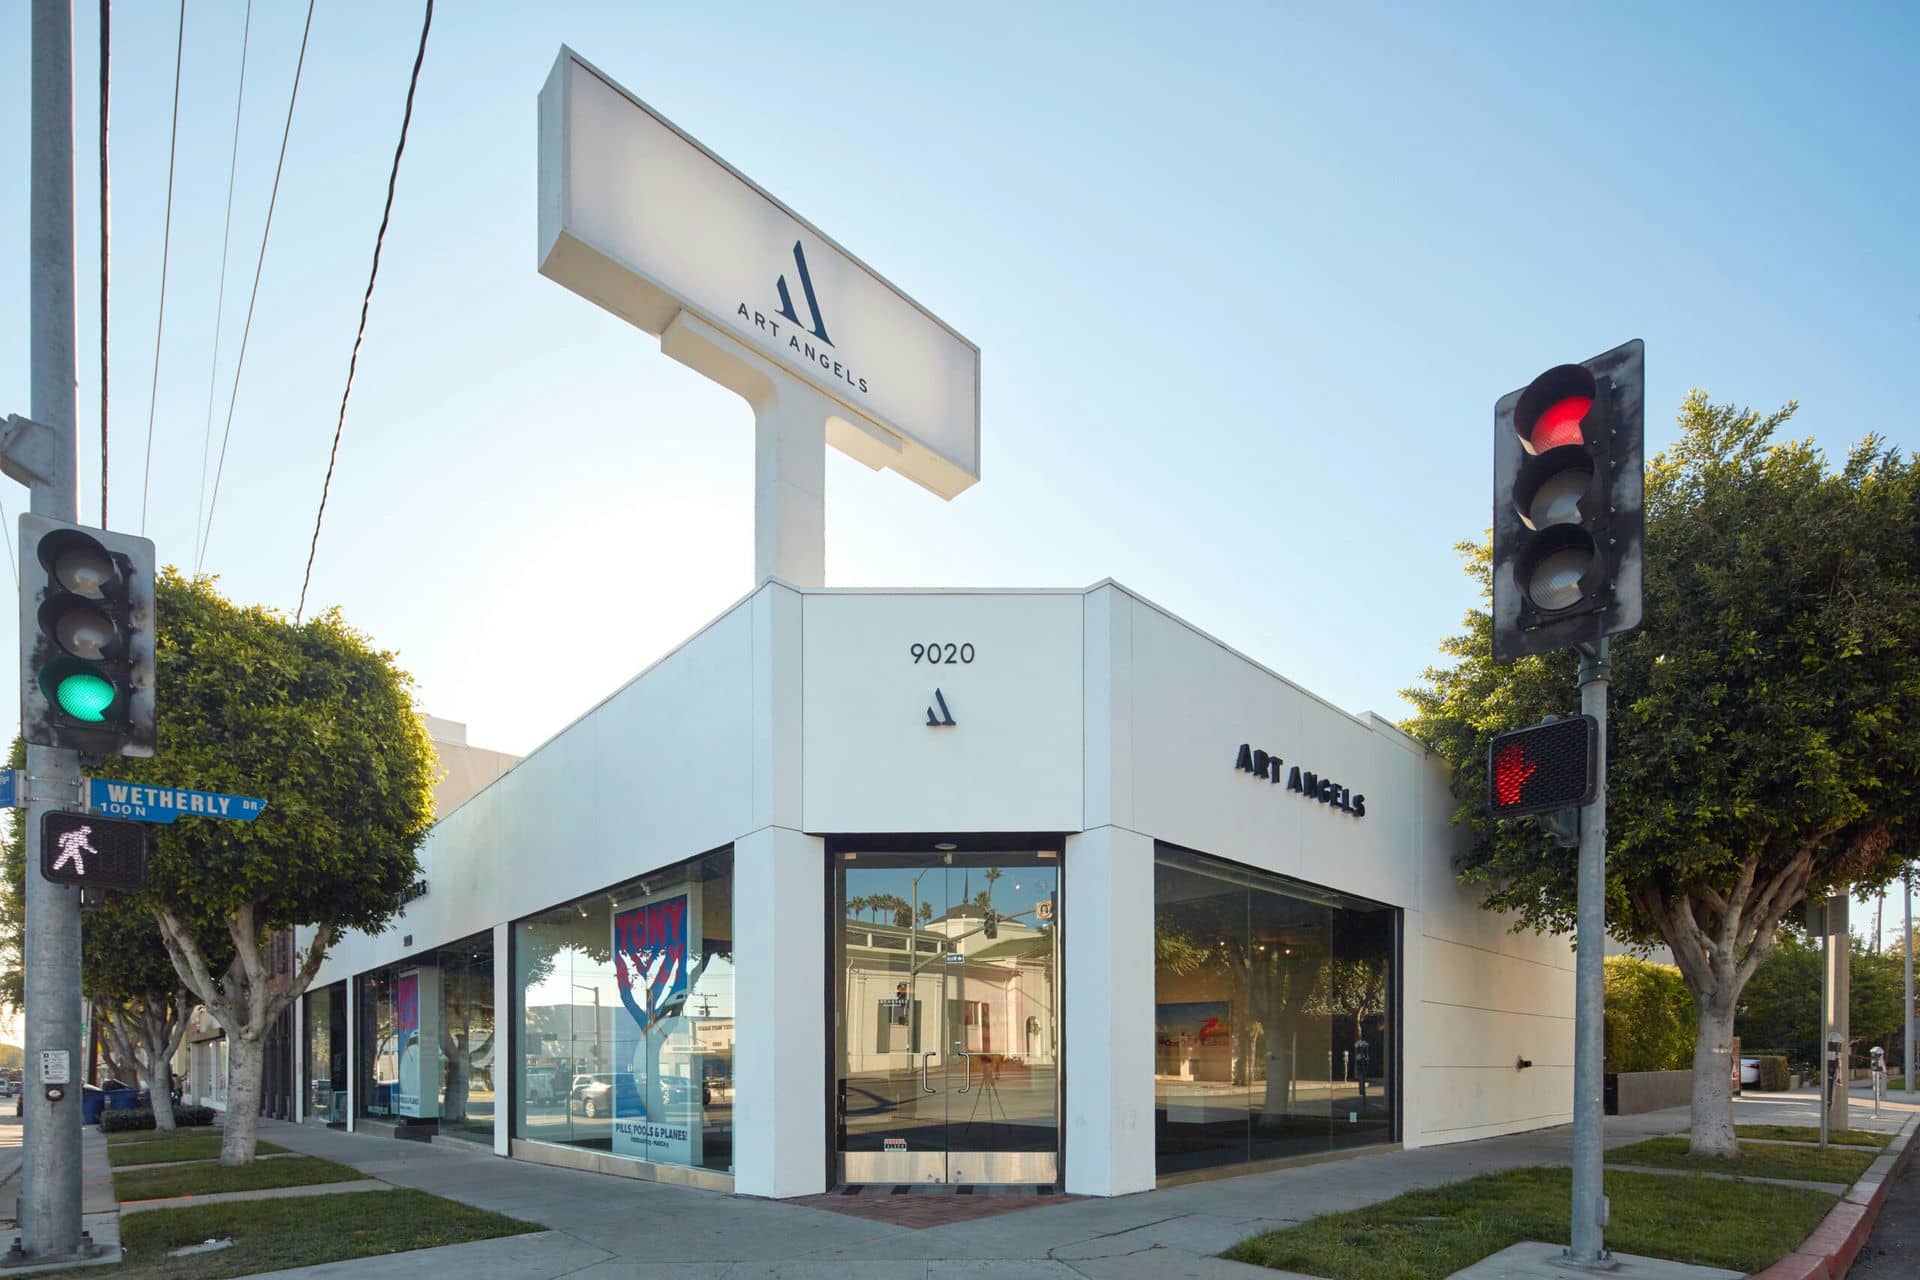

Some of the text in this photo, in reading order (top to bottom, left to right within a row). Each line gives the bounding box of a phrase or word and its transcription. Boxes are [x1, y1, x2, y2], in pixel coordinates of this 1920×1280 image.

[738, 302, 868, 393] ART ANGELS
[910, 643, 975, 664] 9020
[1235, 743, 1365, 818] ART ANGELS
[100, 802, 146, 817] 100 N
[107, 783, 258, 815] WETHERLY DR
[616, 900, 685, 951] TONY
[633, 1125, 653, 1137] POOLS
[654, 1127, 660, 1138] &
